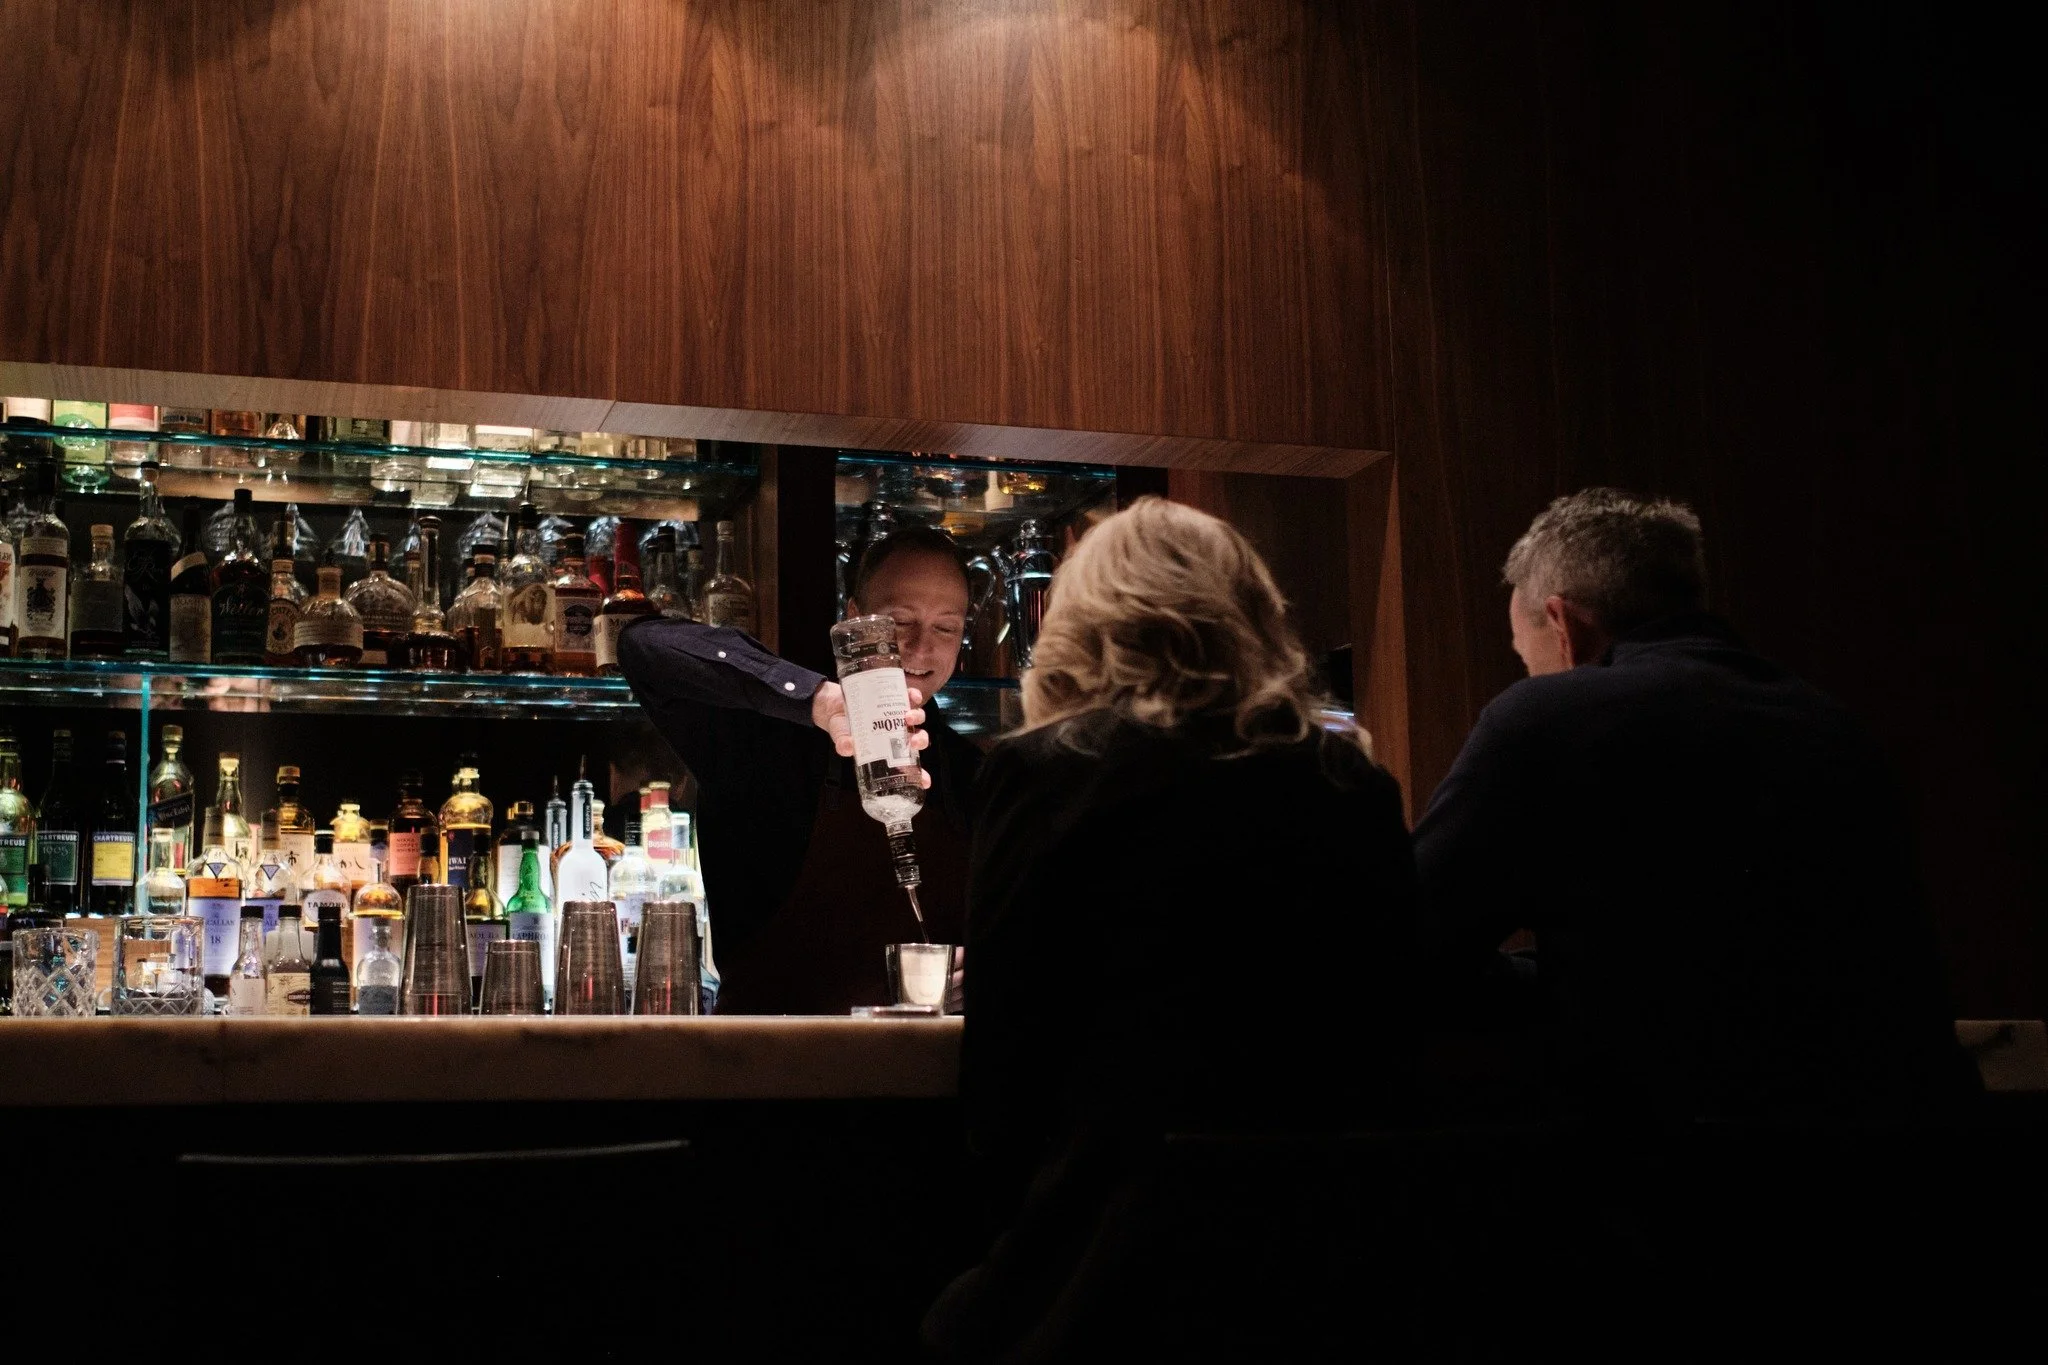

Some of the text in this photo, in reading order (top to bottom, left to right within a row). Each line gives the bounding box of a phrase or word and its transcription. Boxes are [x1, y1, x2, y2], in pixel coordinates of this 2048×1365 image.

[872, 717, 908, 732] etel One
[0, 839, 26, 847] TREUSE
[448, 856, 467, 866] IWAI
[205, 919, 235, 927] CALLAN
[210, 935, 222, 945] 18
